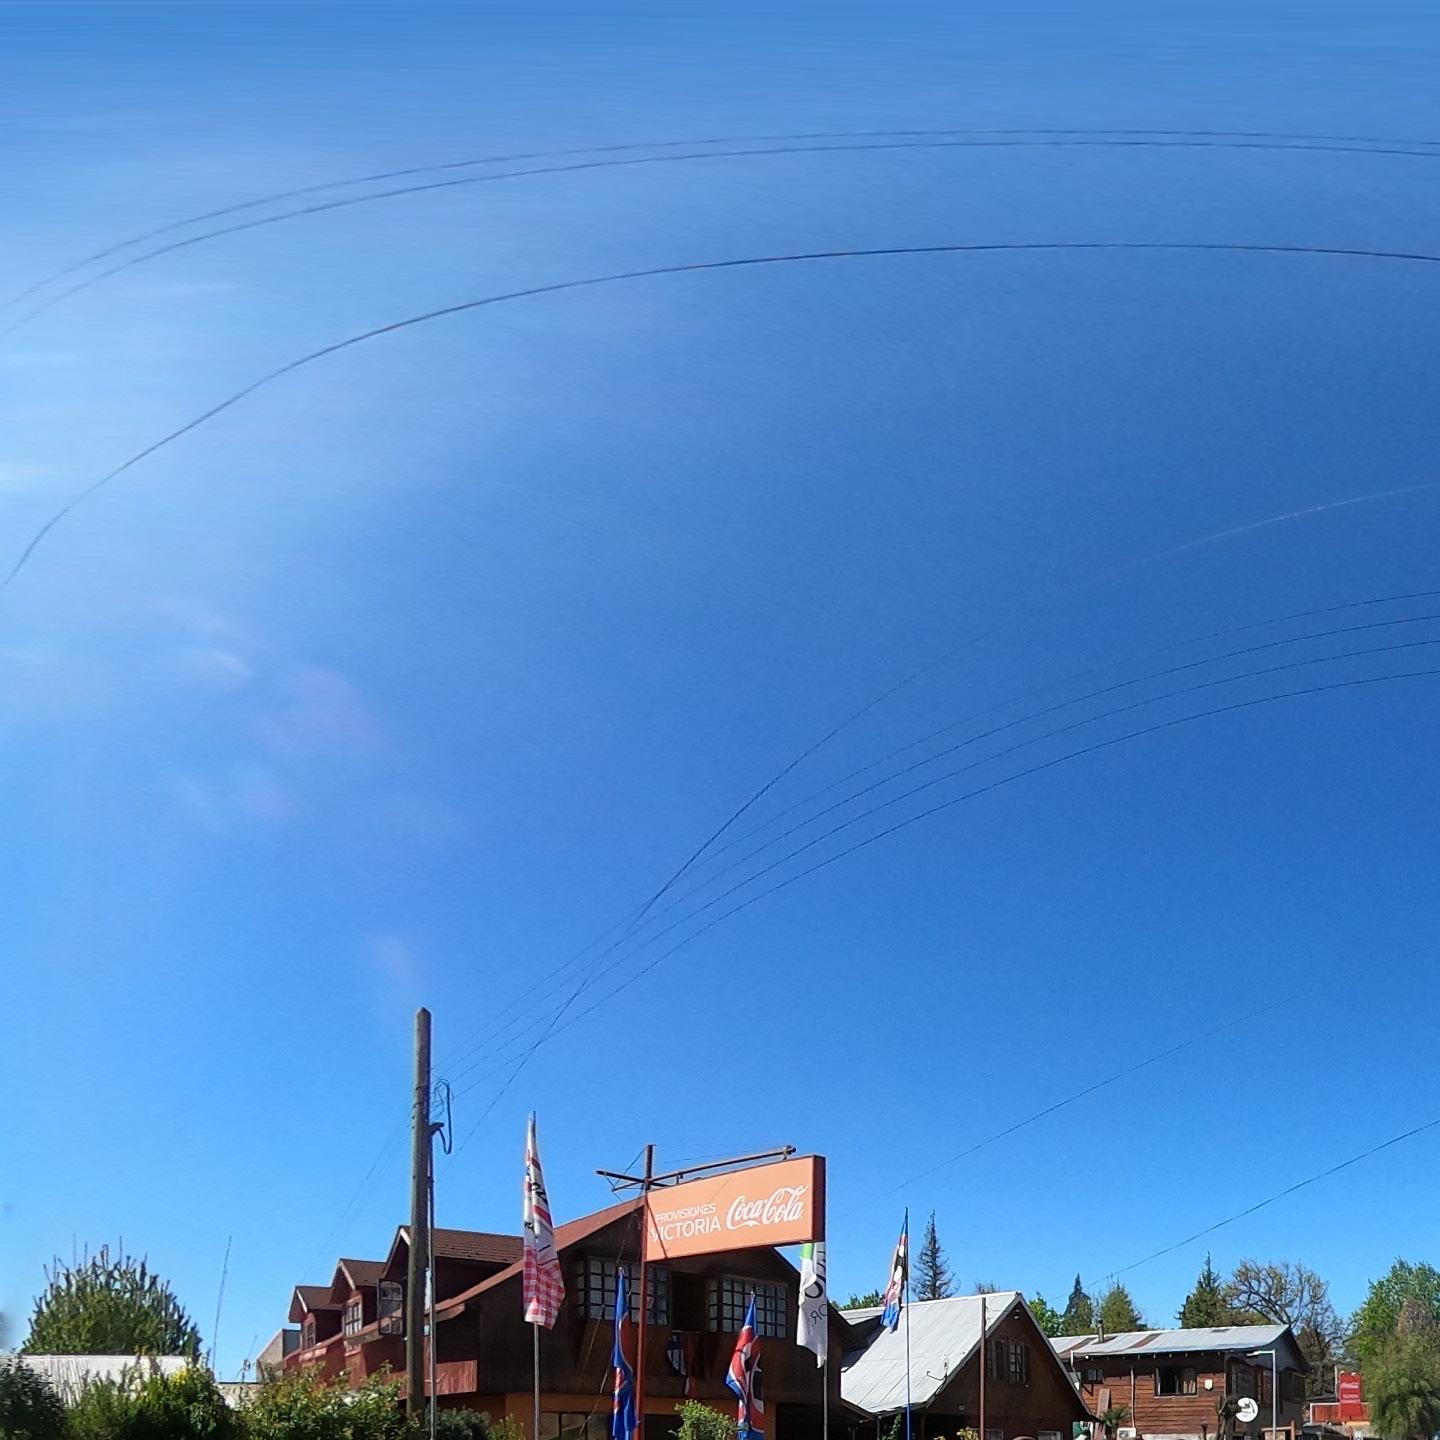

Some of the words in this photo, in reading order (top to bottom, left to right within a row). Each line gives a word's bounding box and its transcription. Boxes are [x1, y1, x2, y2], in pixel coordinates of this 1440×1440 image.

[656, 1203, 716, 1222] PROVISIONES
[726, 1185, 808, 1229] Coca-Cola
[650, 1215, 721, 1242] VICTORIA
